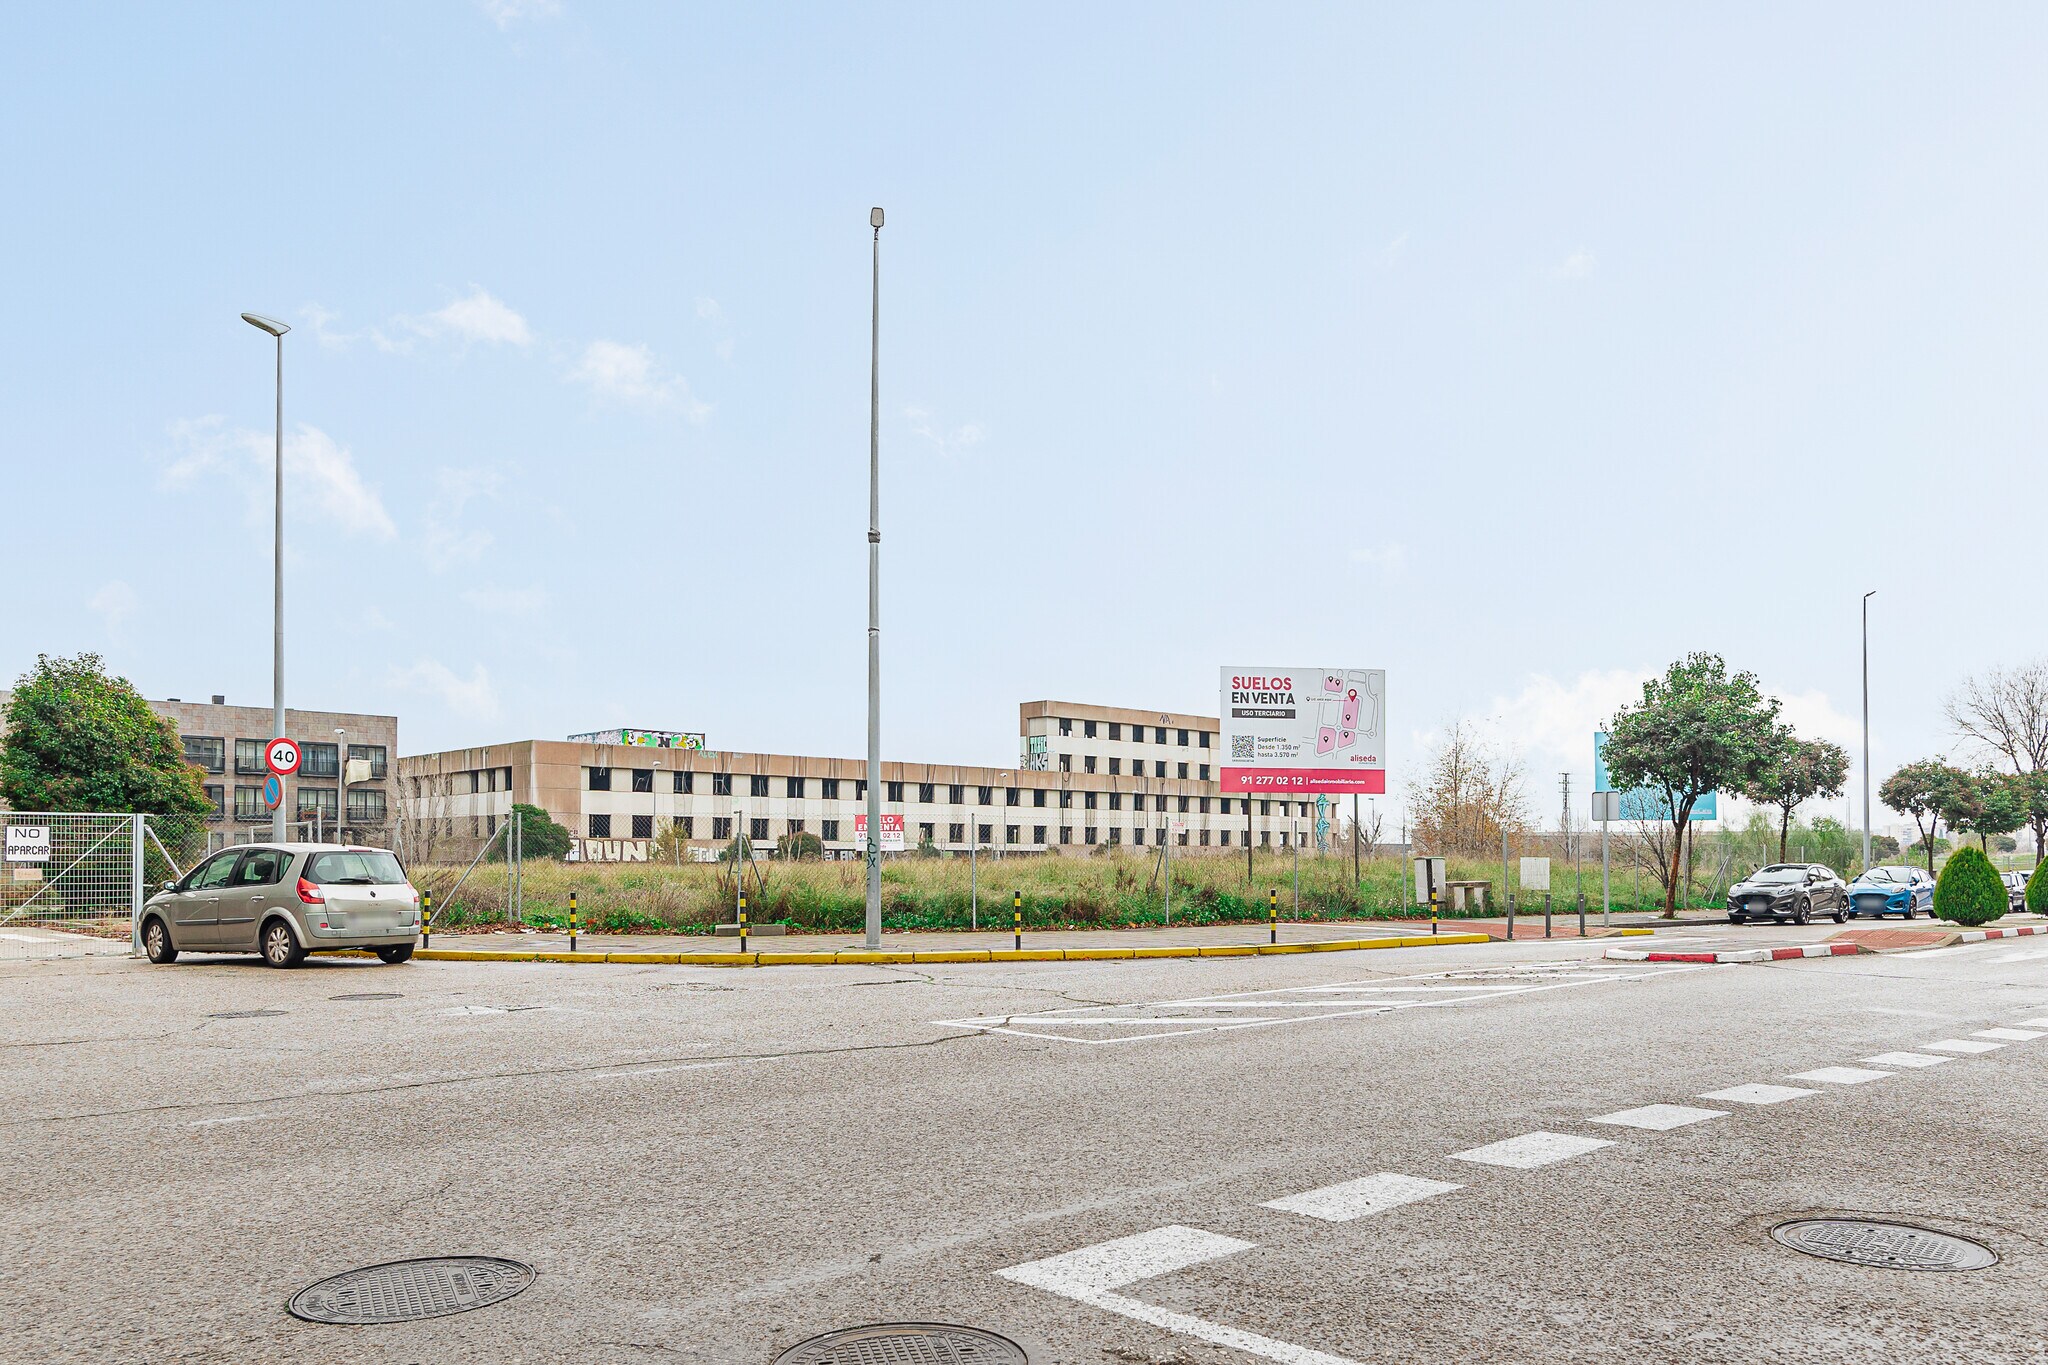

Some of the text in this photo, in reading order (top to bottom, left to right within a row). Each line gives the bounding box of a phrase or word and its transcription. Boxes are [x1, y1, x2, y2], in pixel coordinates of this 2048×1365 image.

[1231, 676, 1292, 691] SUELOS
[1231, 692, 1296, 705] EN VENTA
[273, 750, 295, 763] 40
[1350, 754, 1377, 762] aliseda
[1241, 775, 1253, 785] 91
[1255, 776, 1274, 785] 277
[1276, 776, 1289, 785] 02
[1291, 776, 1304, 786] 12
[15, 828, 40, 839] NO
[7, 845, 50, 855] APARCAR
